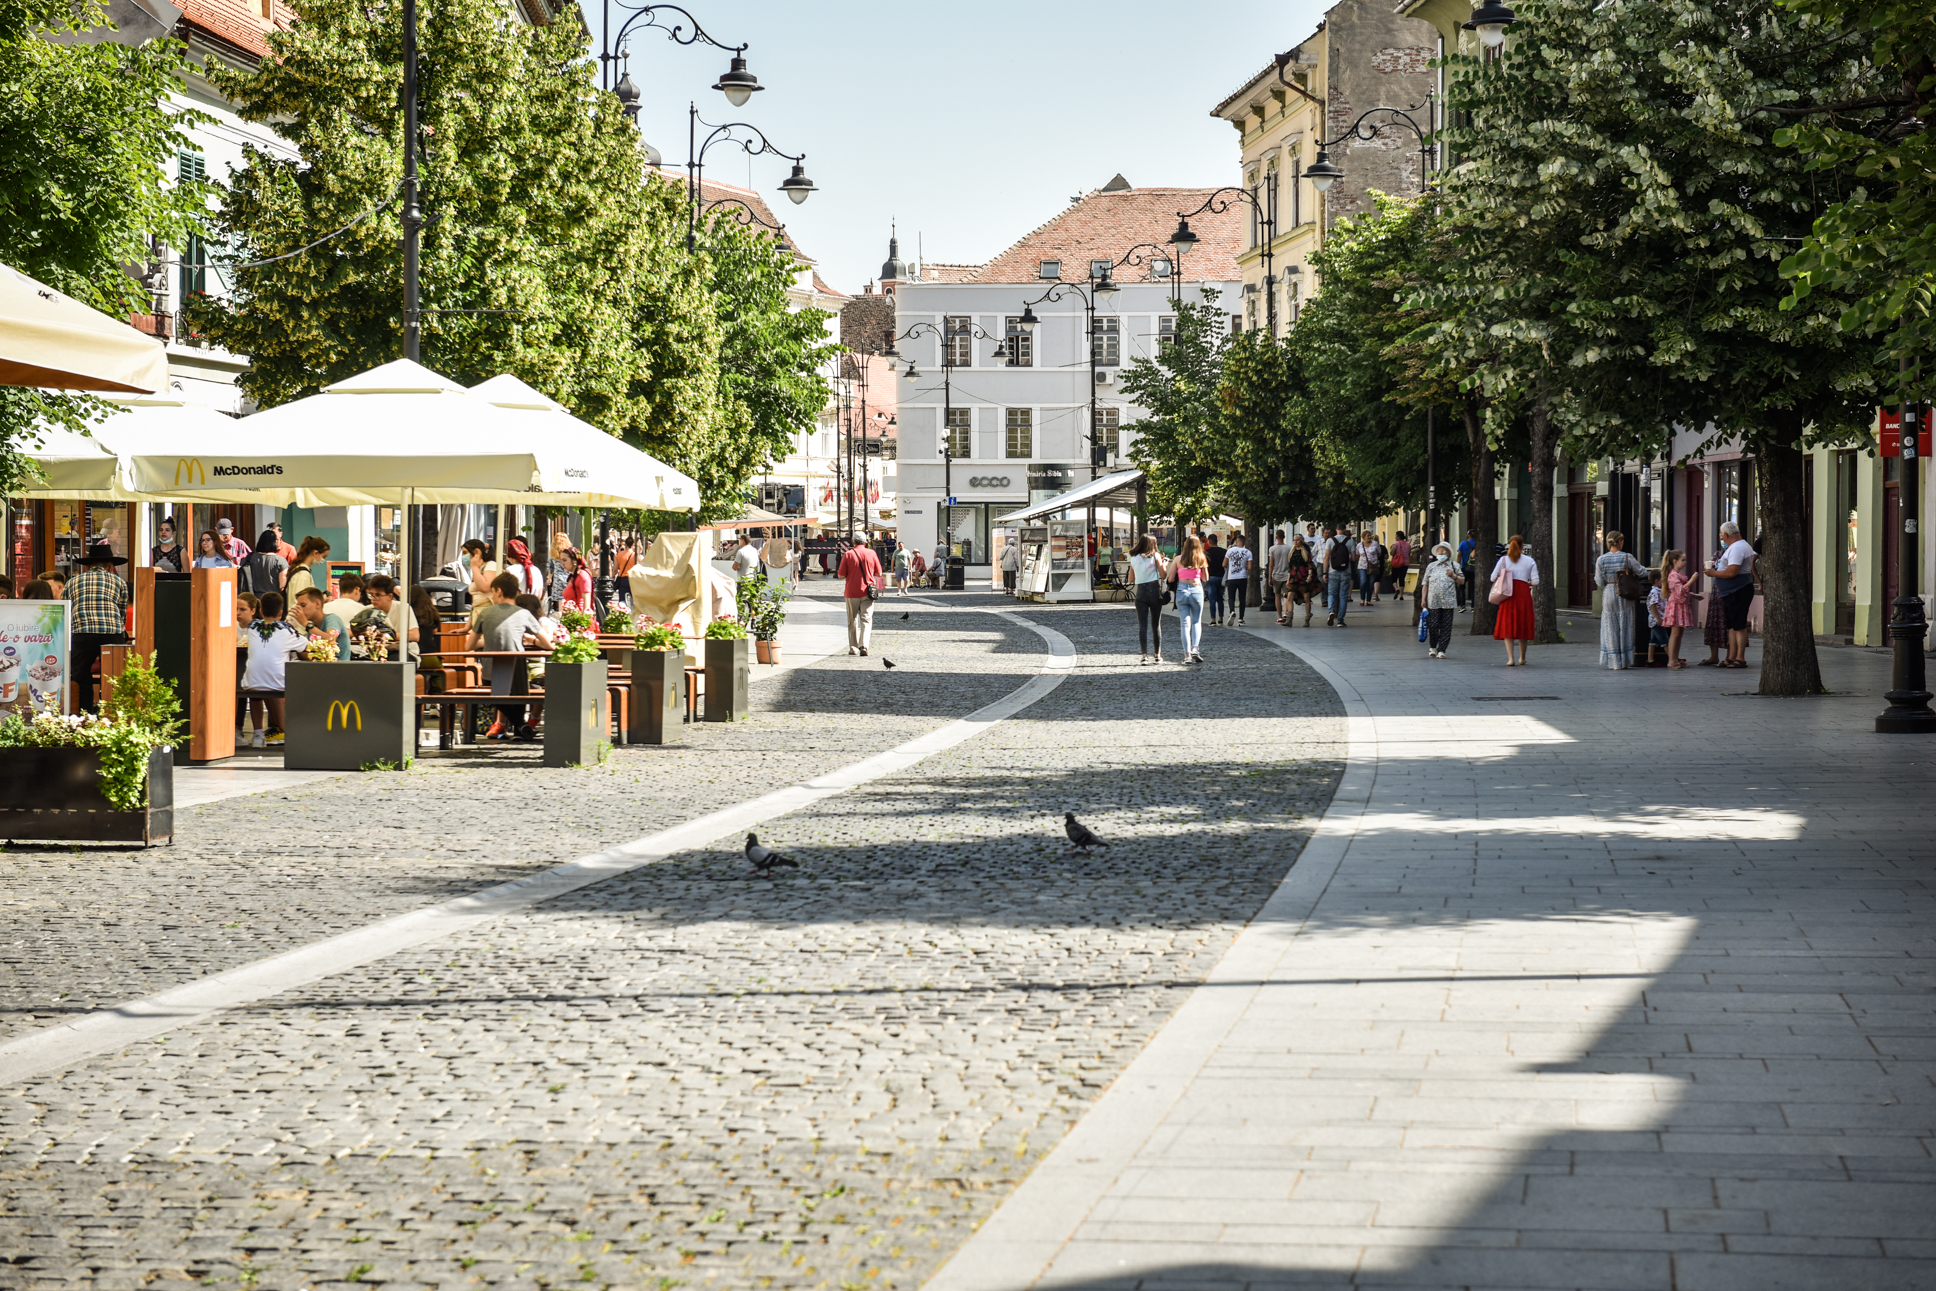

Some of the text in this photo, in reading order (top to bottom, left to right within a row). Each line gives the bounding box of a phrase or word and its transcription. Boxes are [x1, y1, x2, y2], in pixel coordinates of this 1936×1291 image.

[213, 464, 284, 477] McDonald's
[969, 476, 1010, 487] ecco
[17, 624, 40, 632] iubire
[0, 630, 54, 643] e-o vară
